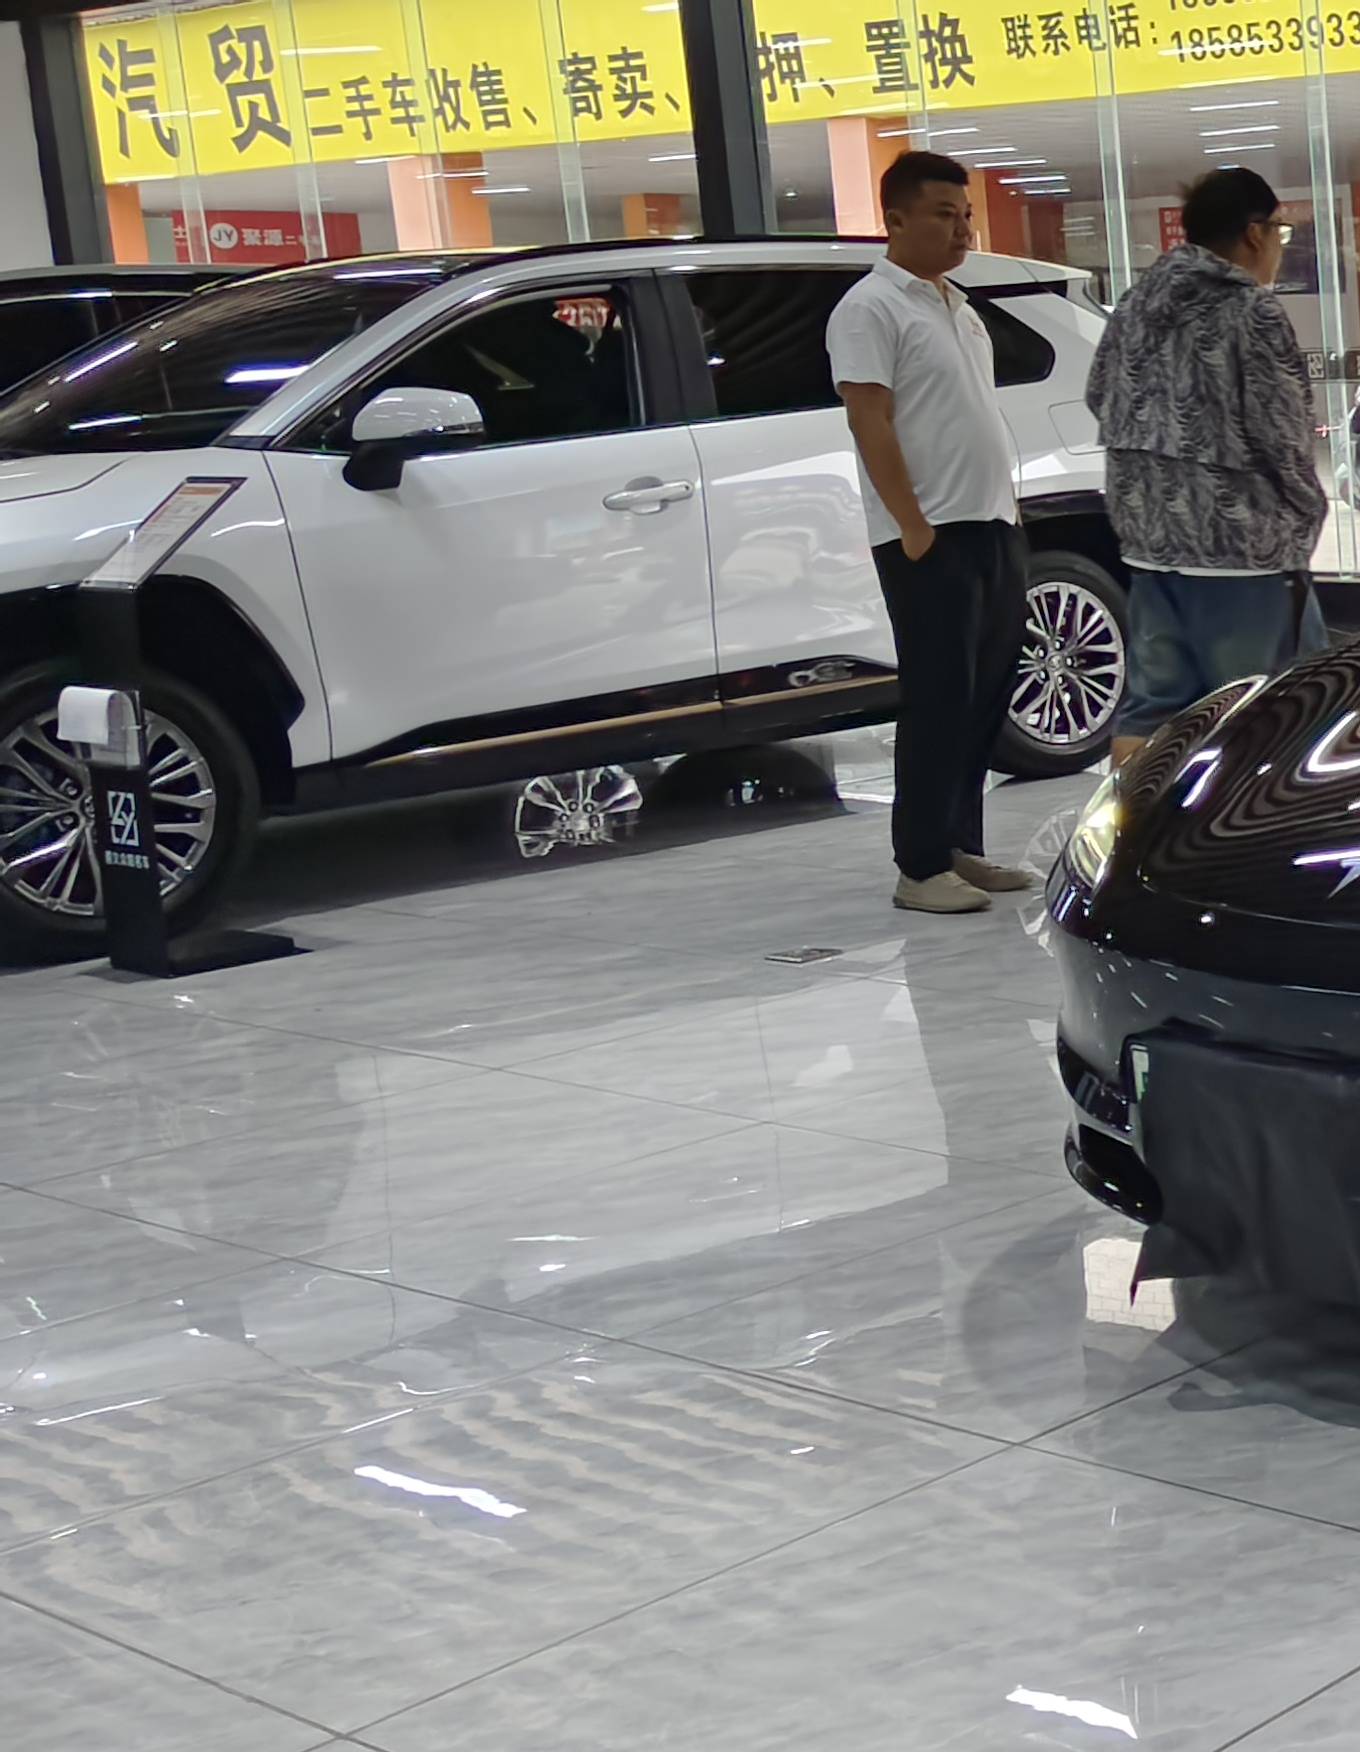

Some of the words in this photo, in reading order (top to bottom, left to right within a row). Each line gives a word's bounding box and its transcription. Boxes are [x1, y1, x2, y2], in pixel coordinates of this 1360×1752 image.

[1001, 3, 1159, 59] 联系电话:
[99, 23, 293, 158] 汽贸
